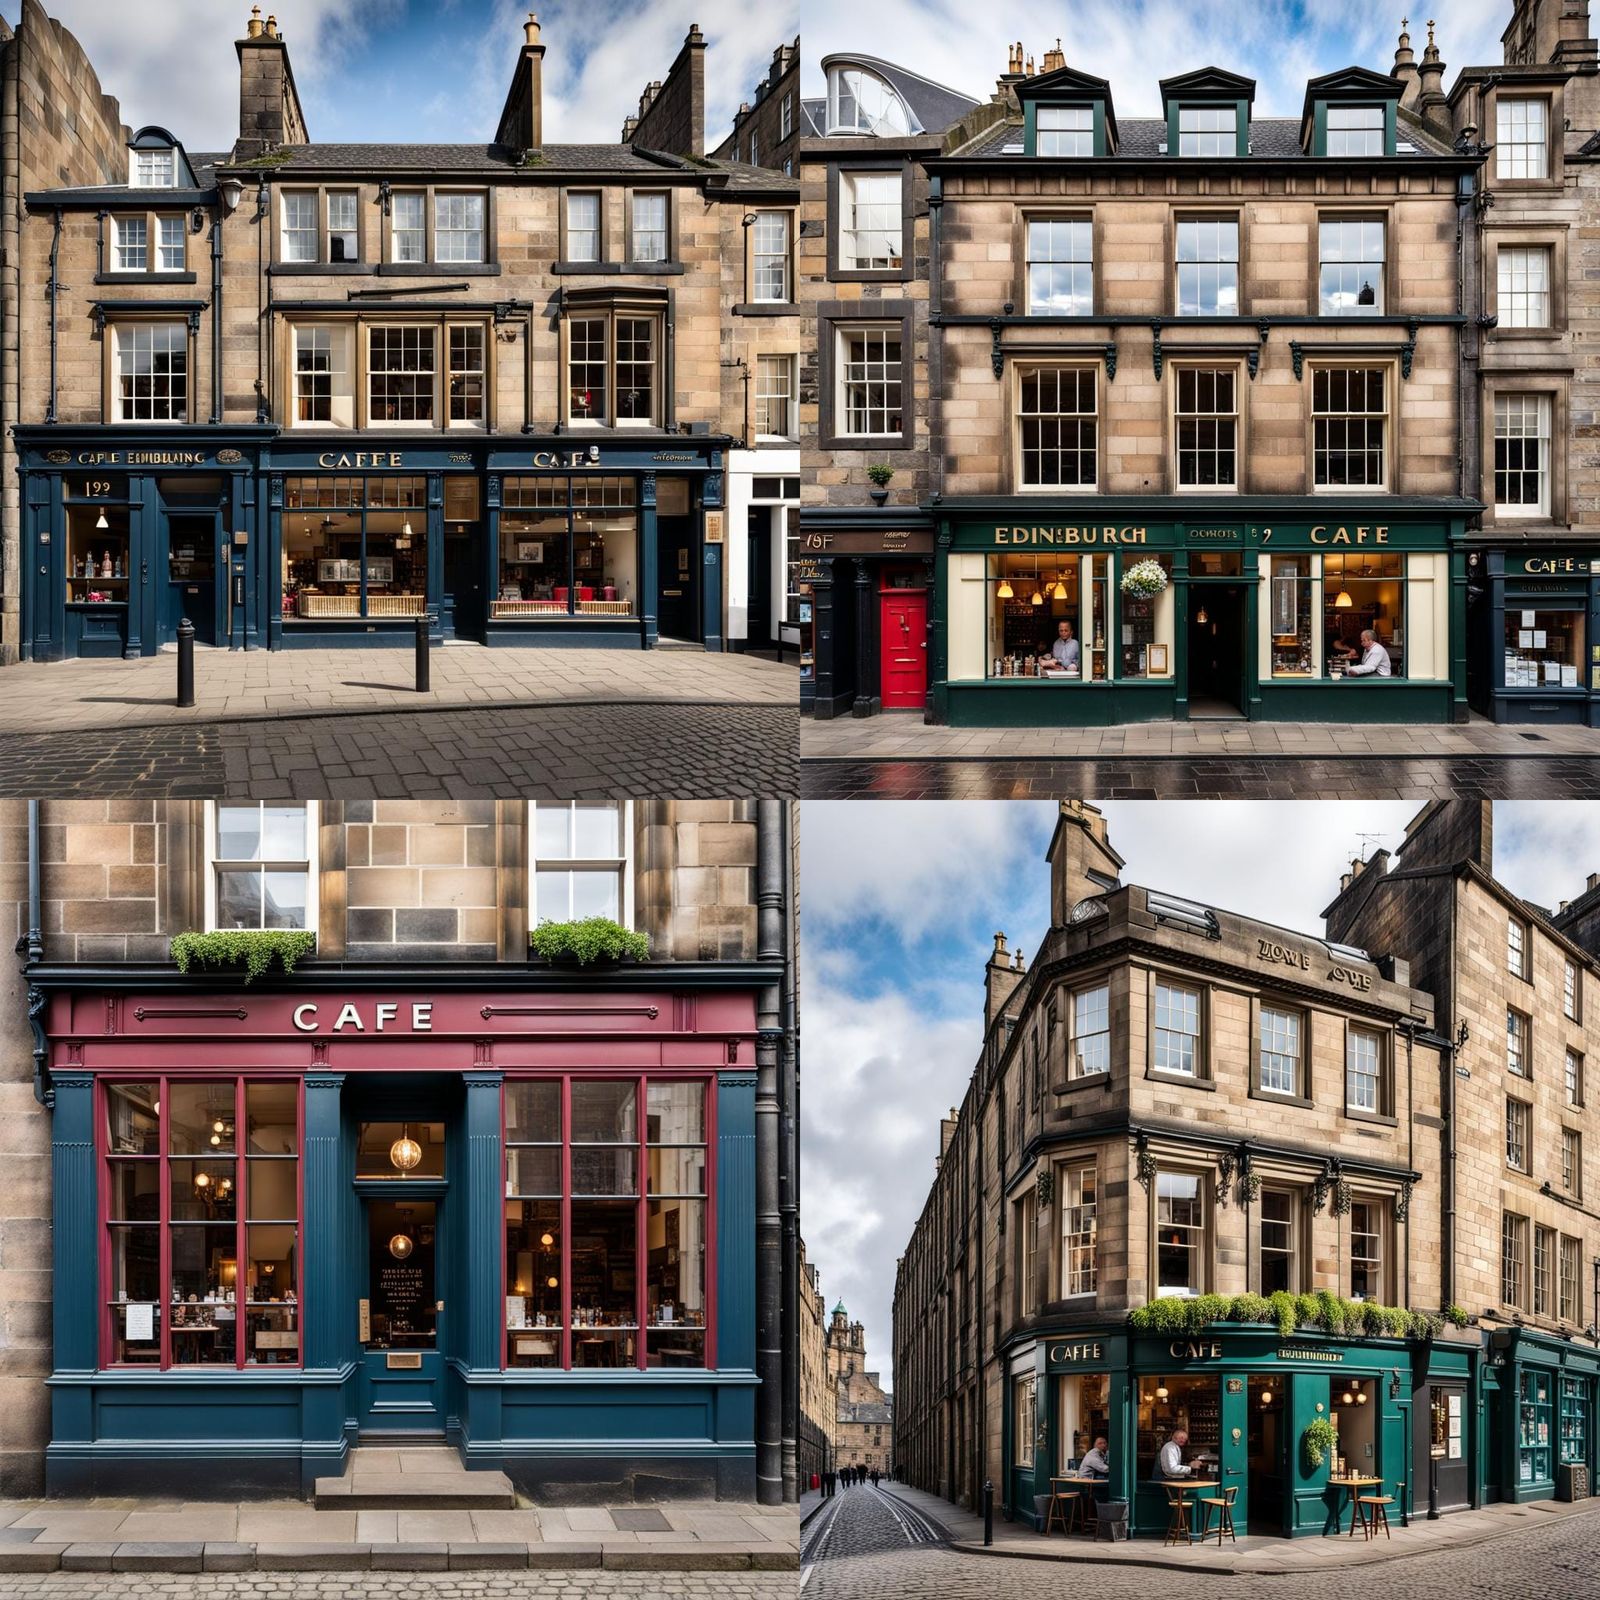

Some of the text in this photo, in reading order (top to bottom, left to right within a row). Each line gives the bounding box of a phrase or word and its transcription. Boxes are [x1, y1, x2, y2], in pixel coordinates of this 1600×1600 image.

[318, 452, 402, 468] CAFFE
[533, 451, 599, 468] CAF
[1310, 526, 1389, 544] CAFE
[292, 1002, 433, 1032] CAFE
[1169, 1341, 1222, 1358] CAFE
